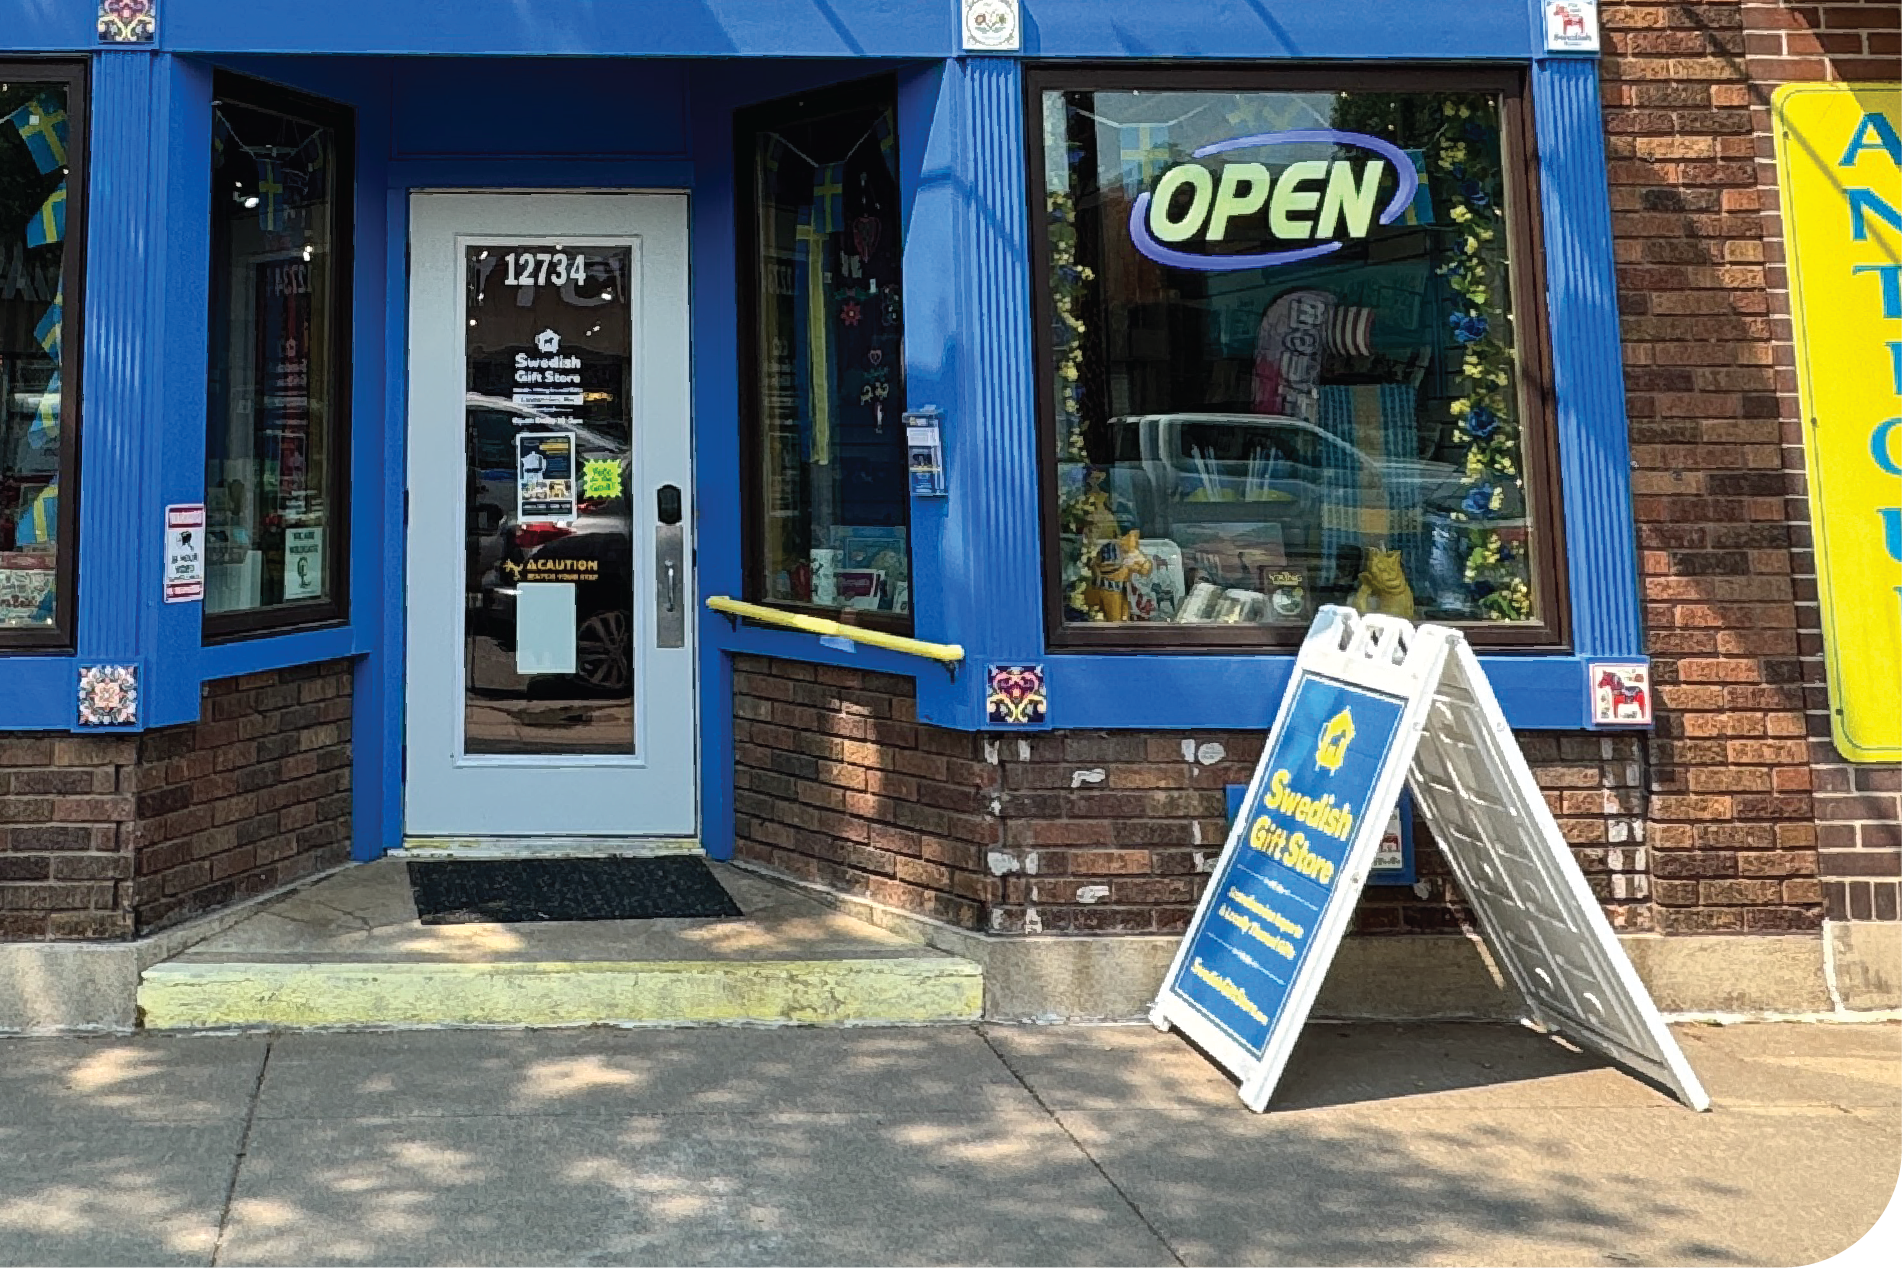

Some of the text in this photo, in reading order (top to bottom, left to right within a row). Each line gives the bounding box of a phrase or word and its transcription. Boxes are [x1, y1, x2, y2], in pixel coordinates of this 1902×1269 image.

[1149, 160, 1386, 242] OPEN
[504, 253, 587, 286] 12734
[514, 353, 581, 369] Swedish
[514, 370, 581, 383] Gift Store
[538, 558, 598, 572] CAUTION
[1264, 768, 1353, 841] Swedish
[1250, 815, 1335, 884] Gift Store
